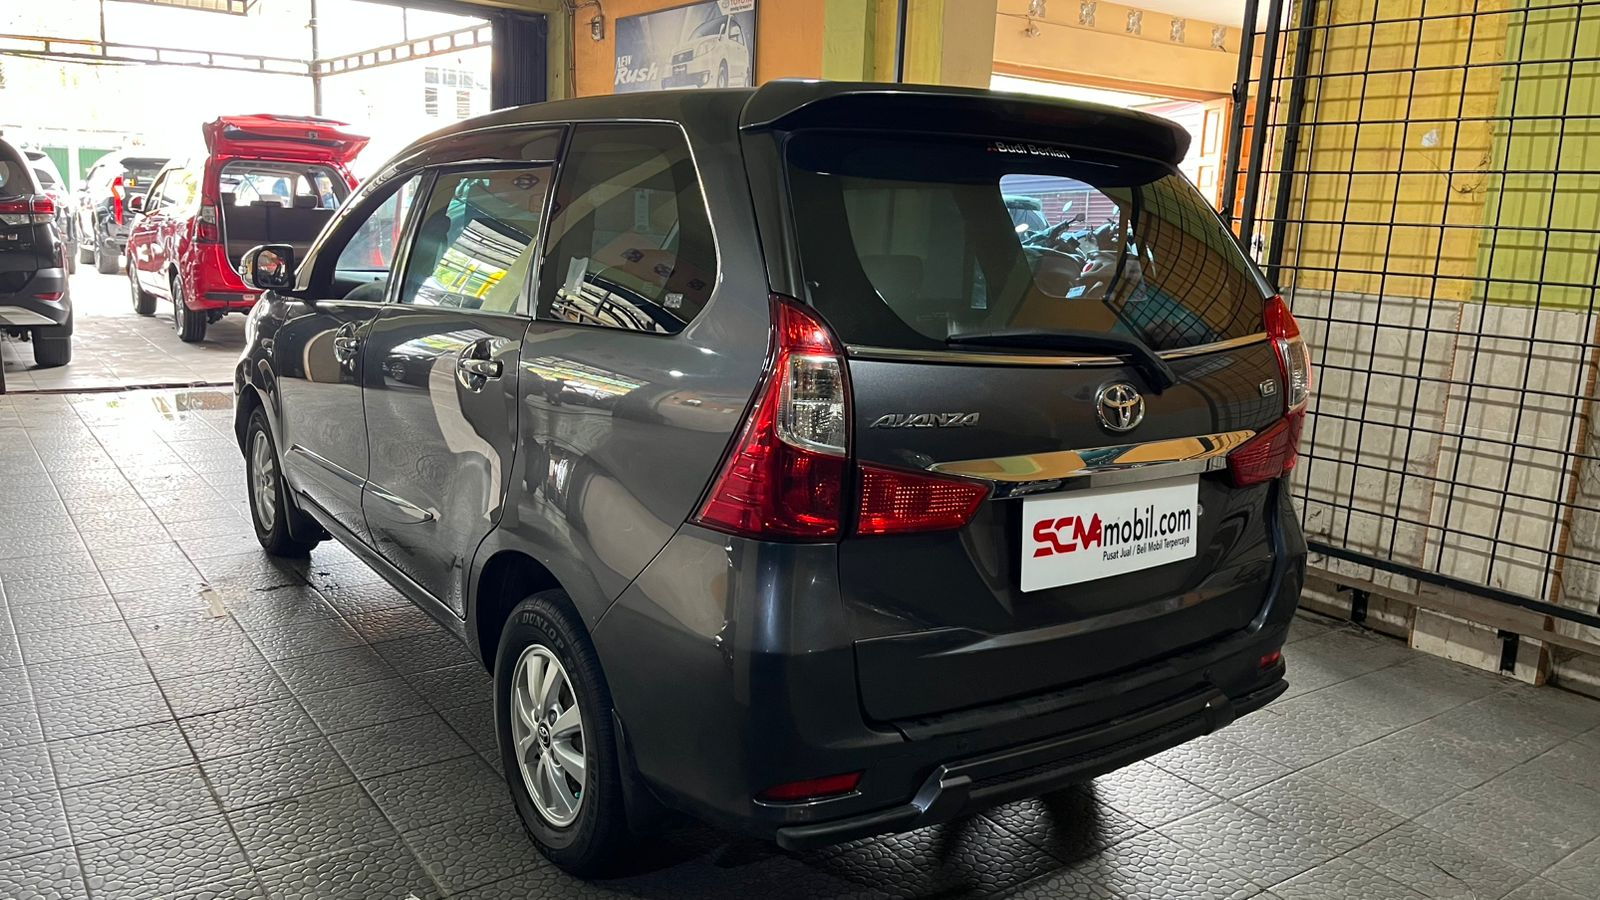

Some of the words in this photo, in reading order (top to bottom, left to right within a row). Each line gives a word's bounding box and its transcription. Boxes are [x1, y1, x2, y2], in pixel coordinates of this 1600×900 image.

[614, 62, 658, 85] Rush
[995, 141, 1028, 154] Budi
[869, 412, 980, 428] AVANZA
[1102, 550, 1119, 561] Pusat
[1120, 545, 1132, 558] Jual
[1136, 542, 1147, 555] Beli
[1148, 538, 1163, 552] Mobil
[1164, 536, 1190, 550] Terpercaya
[521, 612, 565, 649] DUNLOP
